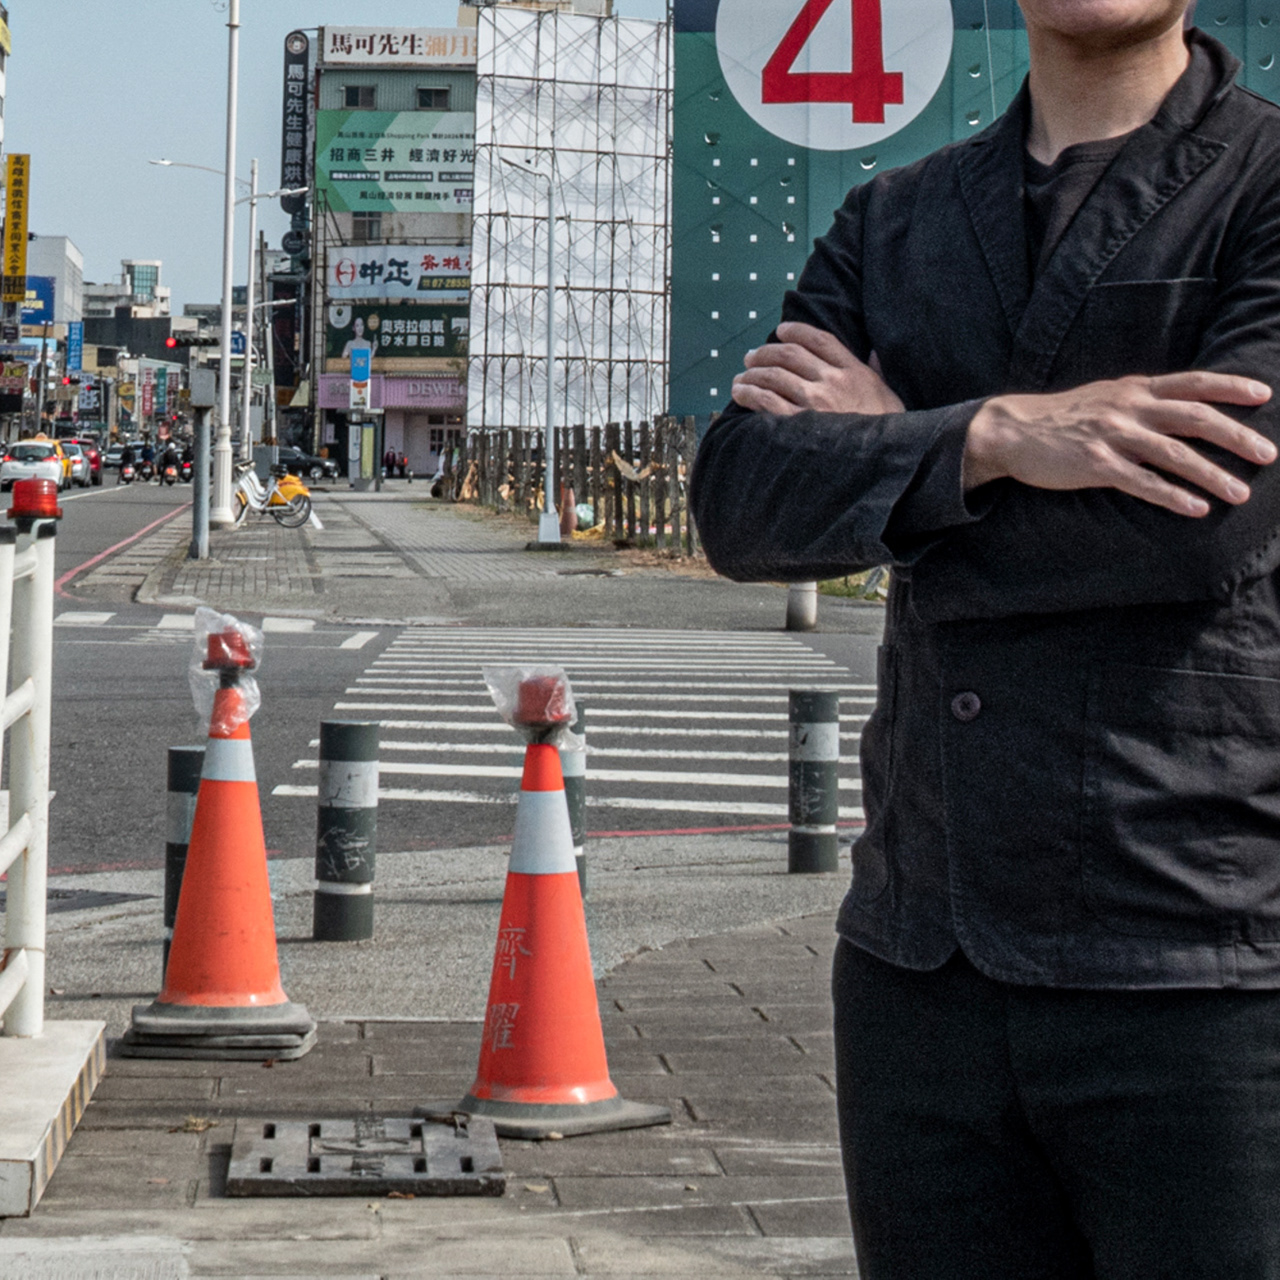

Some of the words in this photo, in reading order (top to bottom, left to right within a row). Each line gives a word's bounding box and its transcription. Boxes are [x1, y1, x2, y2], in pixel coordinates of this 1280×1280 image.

[330, 33, 476, 57] 馬可先生彌月
[330, 148, 395, 161] 招商三井
[359, 258, 412, 286] 中正
